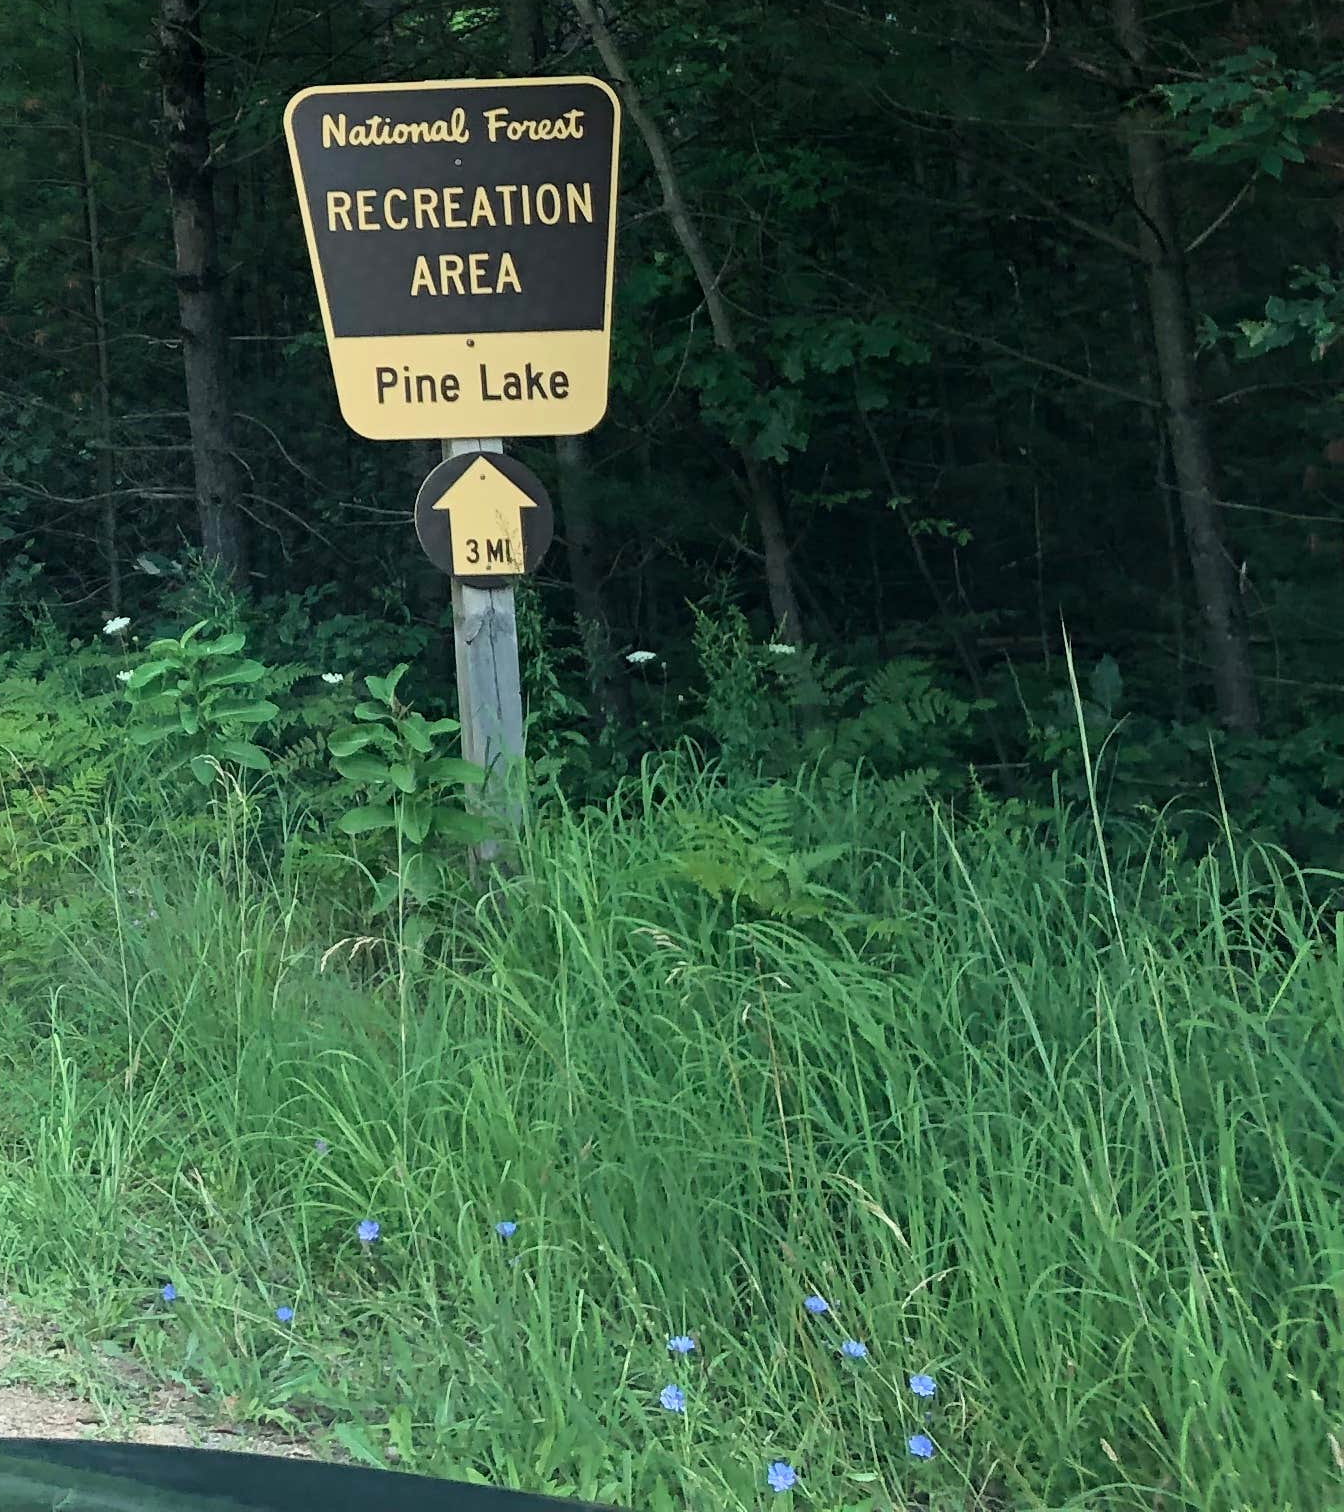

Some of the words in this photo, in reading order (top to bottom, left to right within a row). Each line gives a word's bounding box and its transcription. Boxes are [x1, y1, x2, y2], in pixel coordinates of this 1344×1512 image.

[322, 107, 469, 148] National
[483, 107, 585, 143] Forest
[326, 182, 593, 232] RECREATION
[410, 253, 522, 296] AREA
[376, 365, 461, 404] Pine
[480, 362, 569, 400] Lake
[466, 538, 480, 564] 3
